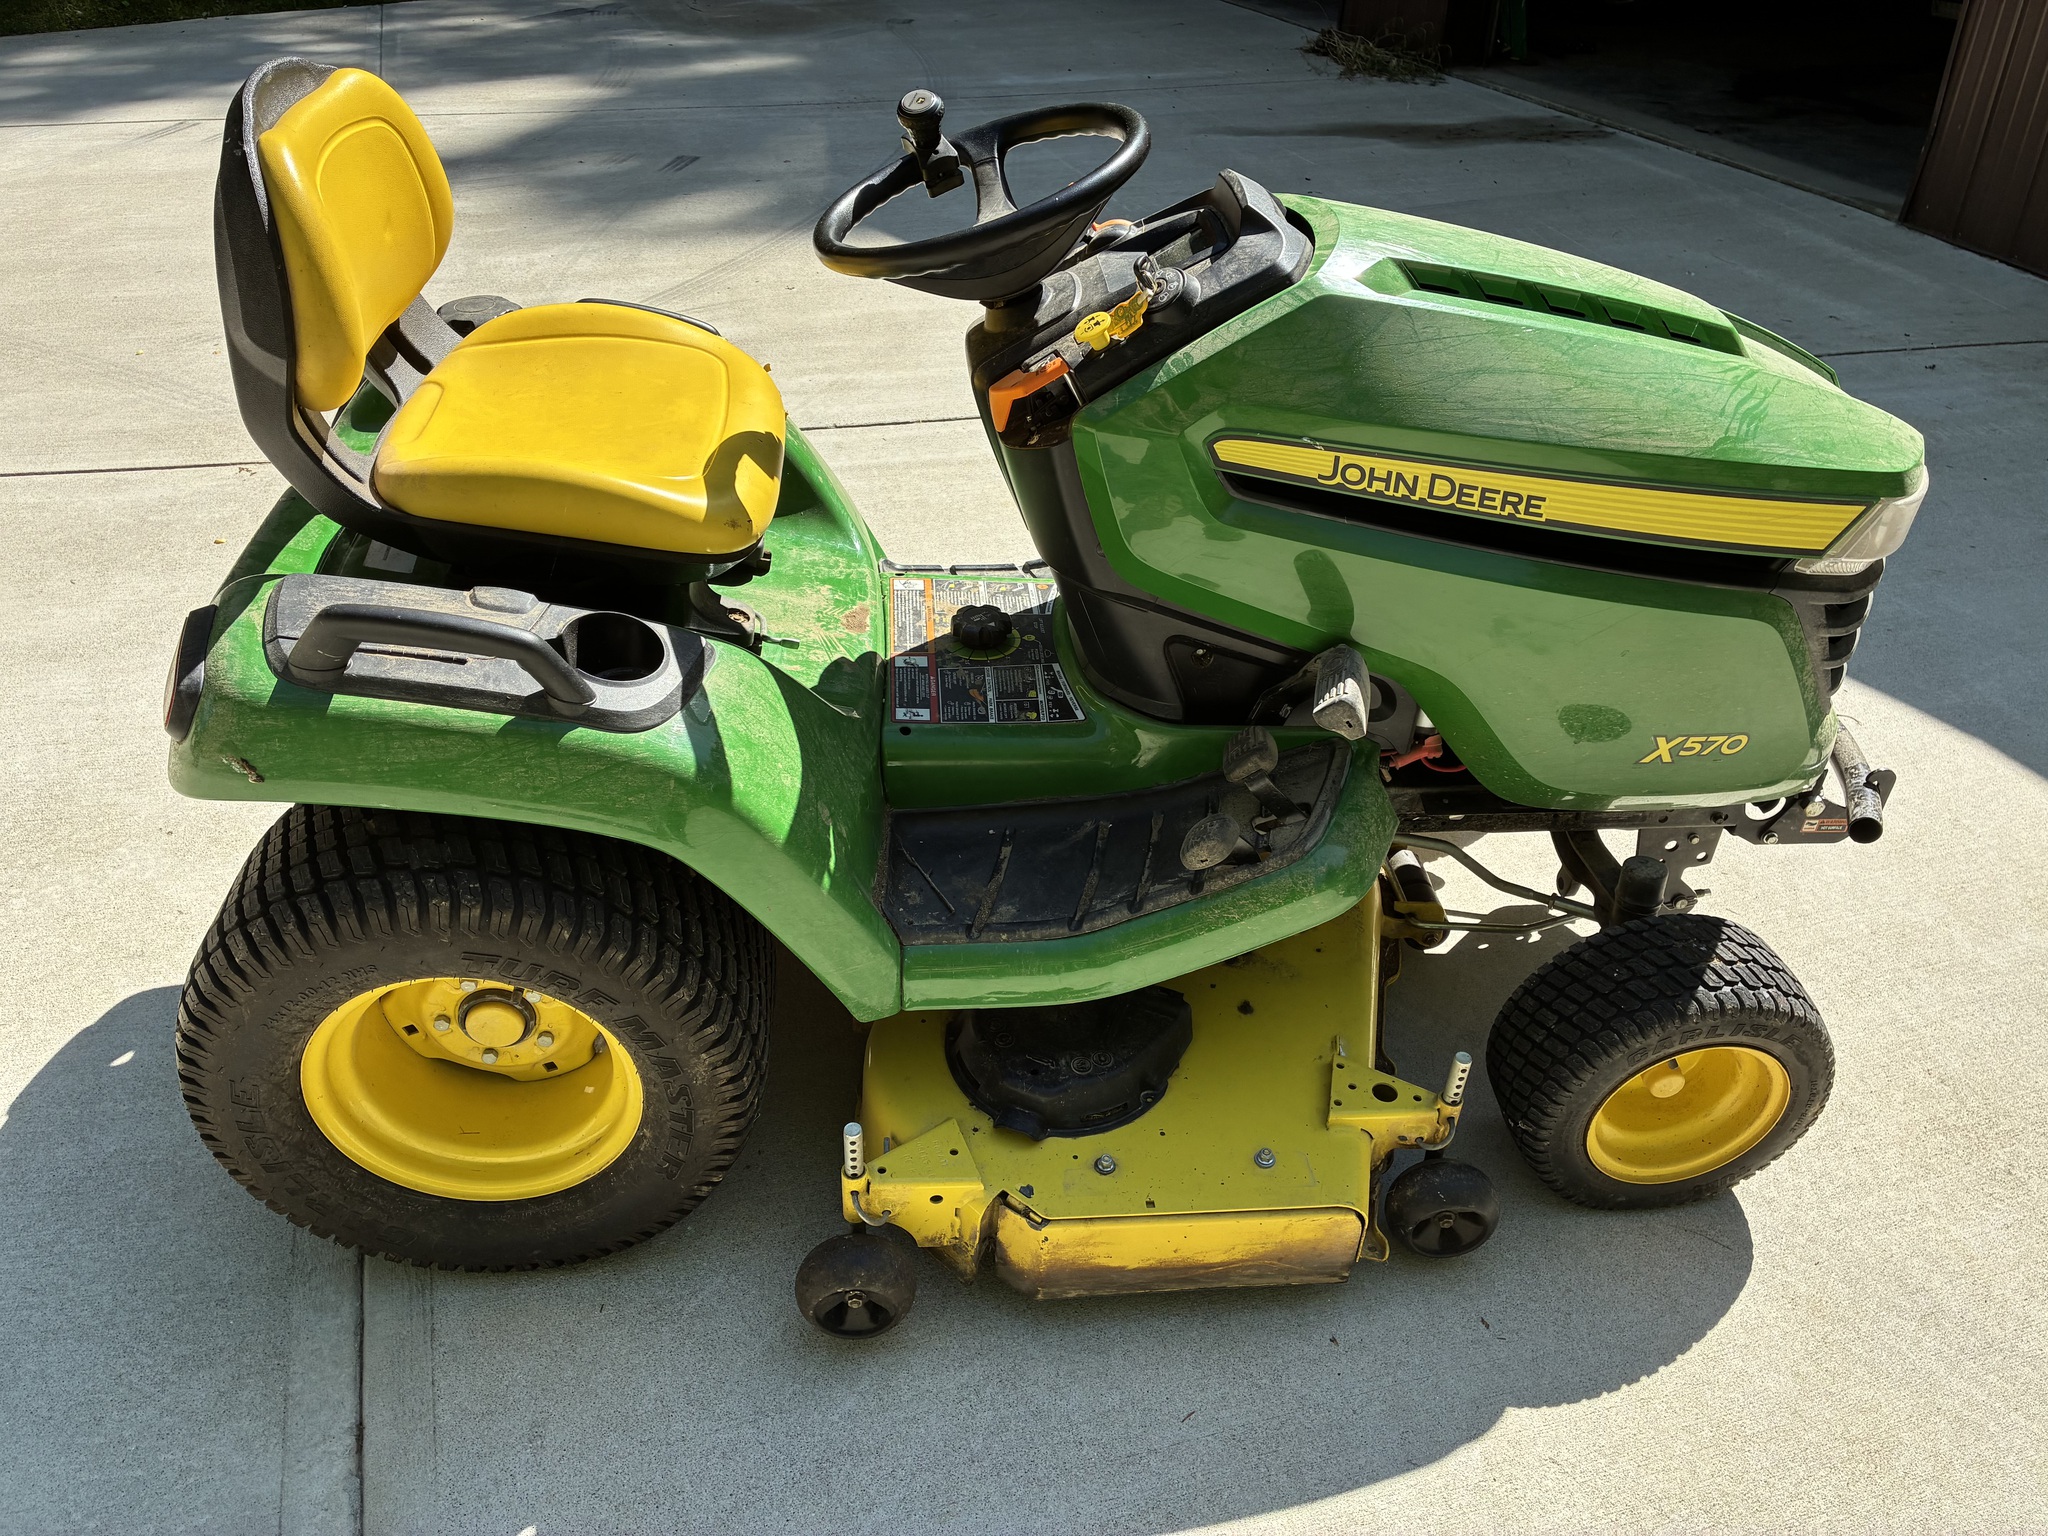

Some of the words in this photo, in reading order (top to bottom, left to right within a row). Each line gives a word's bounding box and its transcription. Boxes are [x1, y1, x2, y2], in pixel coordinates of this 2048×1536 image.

[1317, 454, 1420, 498] JOHN
[1427, 473, 1548, 519] DEERE
[1636, 733, 1750, 764] X570
[460, 951, 621, 1006] TURF
[613, 1014, 696, 1182] MASTER
[1626, 1023, 1803, 1068] CARLISLE
